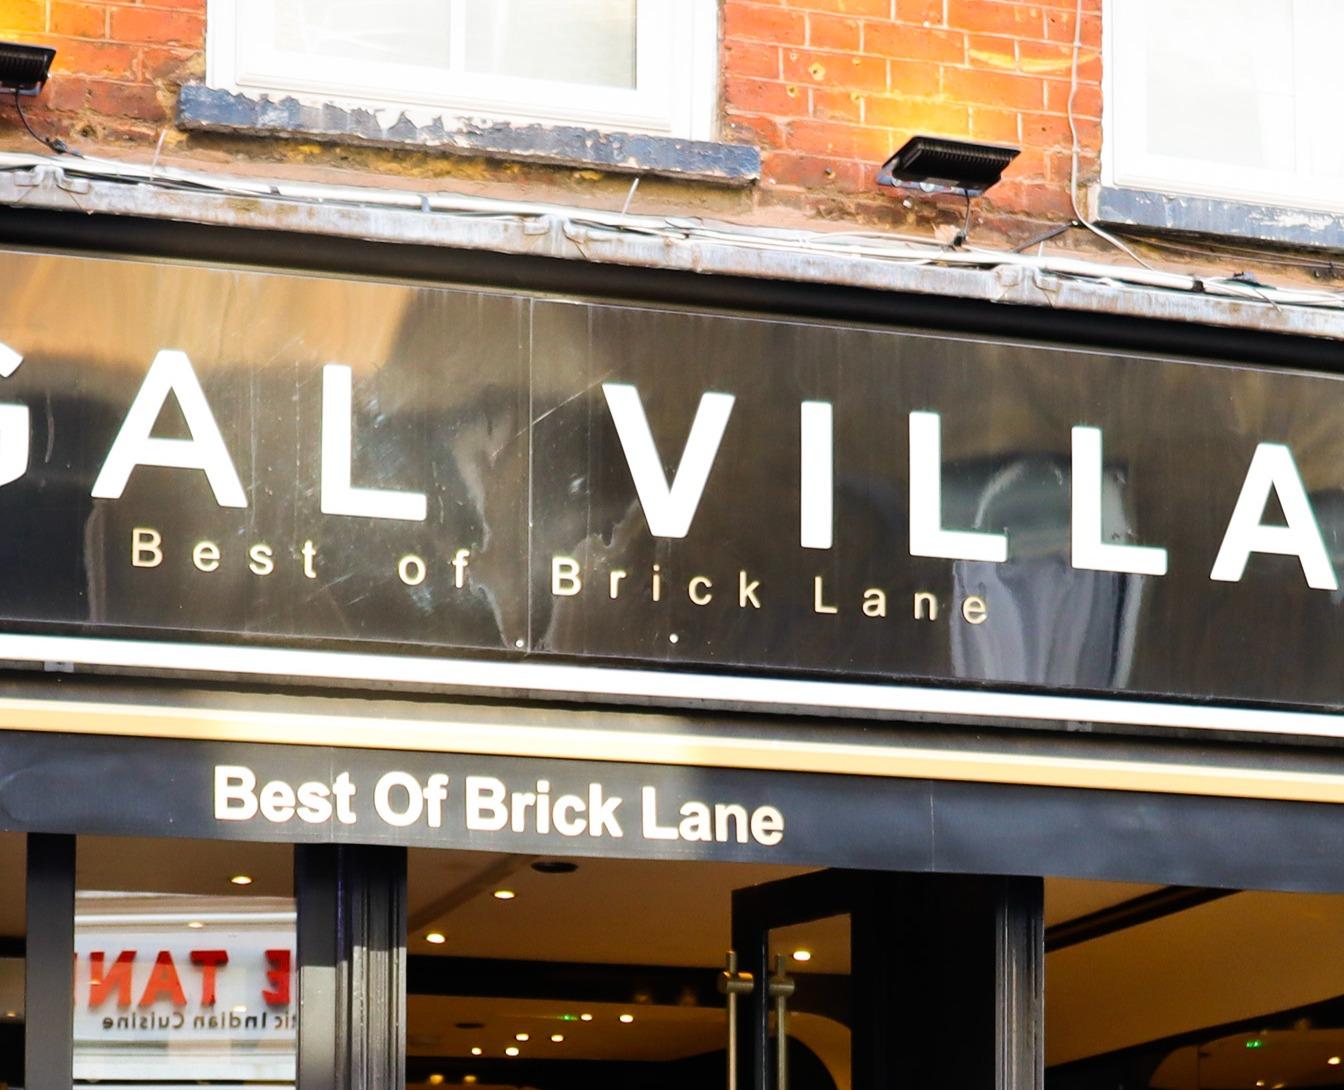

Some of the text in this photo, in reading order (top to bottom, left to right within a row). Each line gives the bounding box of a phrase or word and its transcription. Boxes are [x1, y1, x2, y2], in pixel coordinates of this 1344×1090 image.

[130, 528, 988, 624] Best of Brick Lane
[213, 765, 785, 846] Best Of Brick Lane
